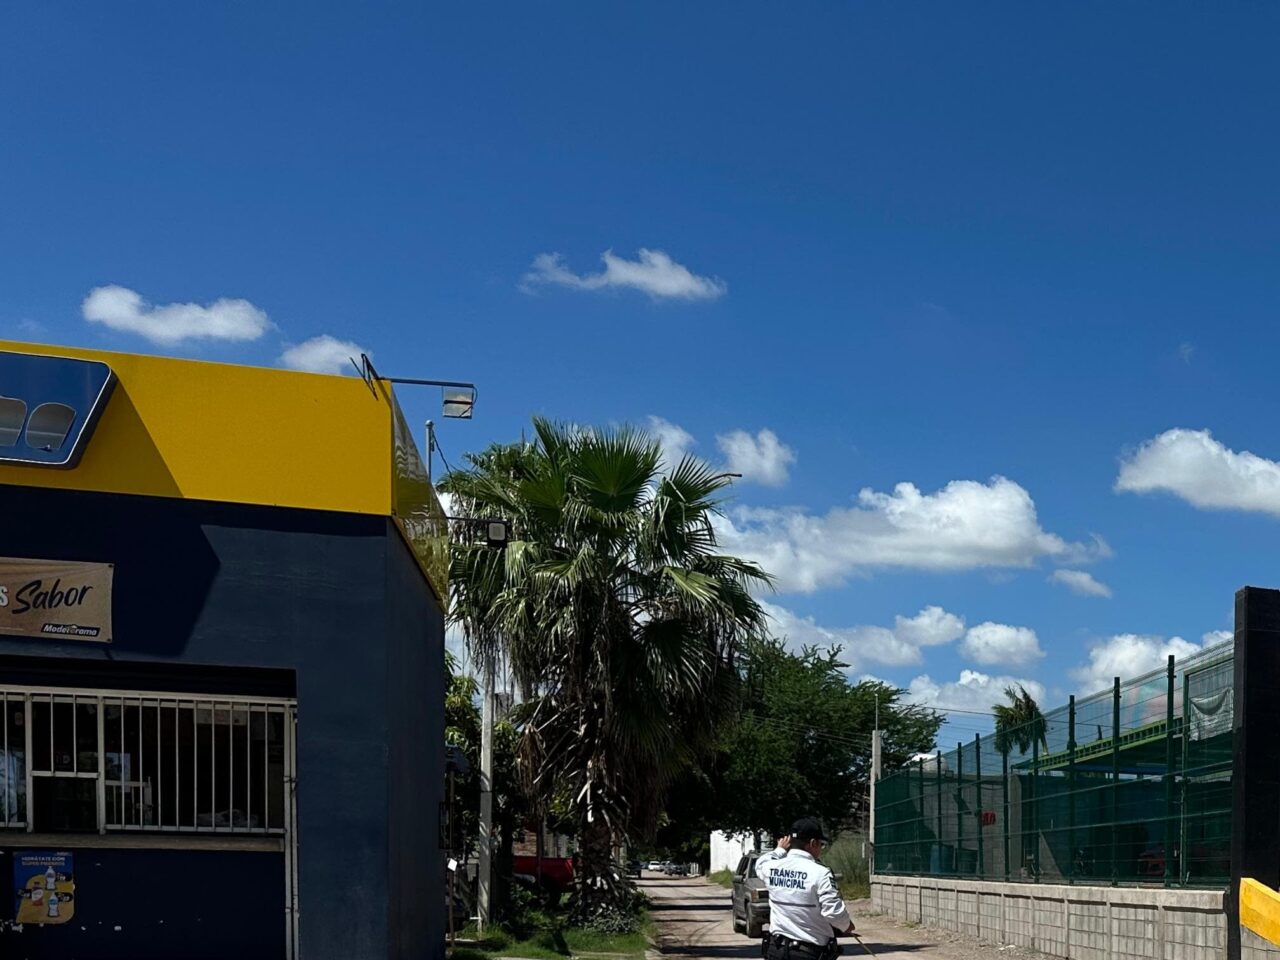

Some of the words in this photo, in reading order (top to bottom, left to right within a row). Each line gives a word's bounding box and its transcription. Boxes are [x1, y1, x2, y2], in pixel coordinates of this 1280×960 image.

[12, 578, 93, 614] Sabor
[770, 868, 807, 879] TRÁNSITO
[769, 877, 806, 889] MUNICIPAL
